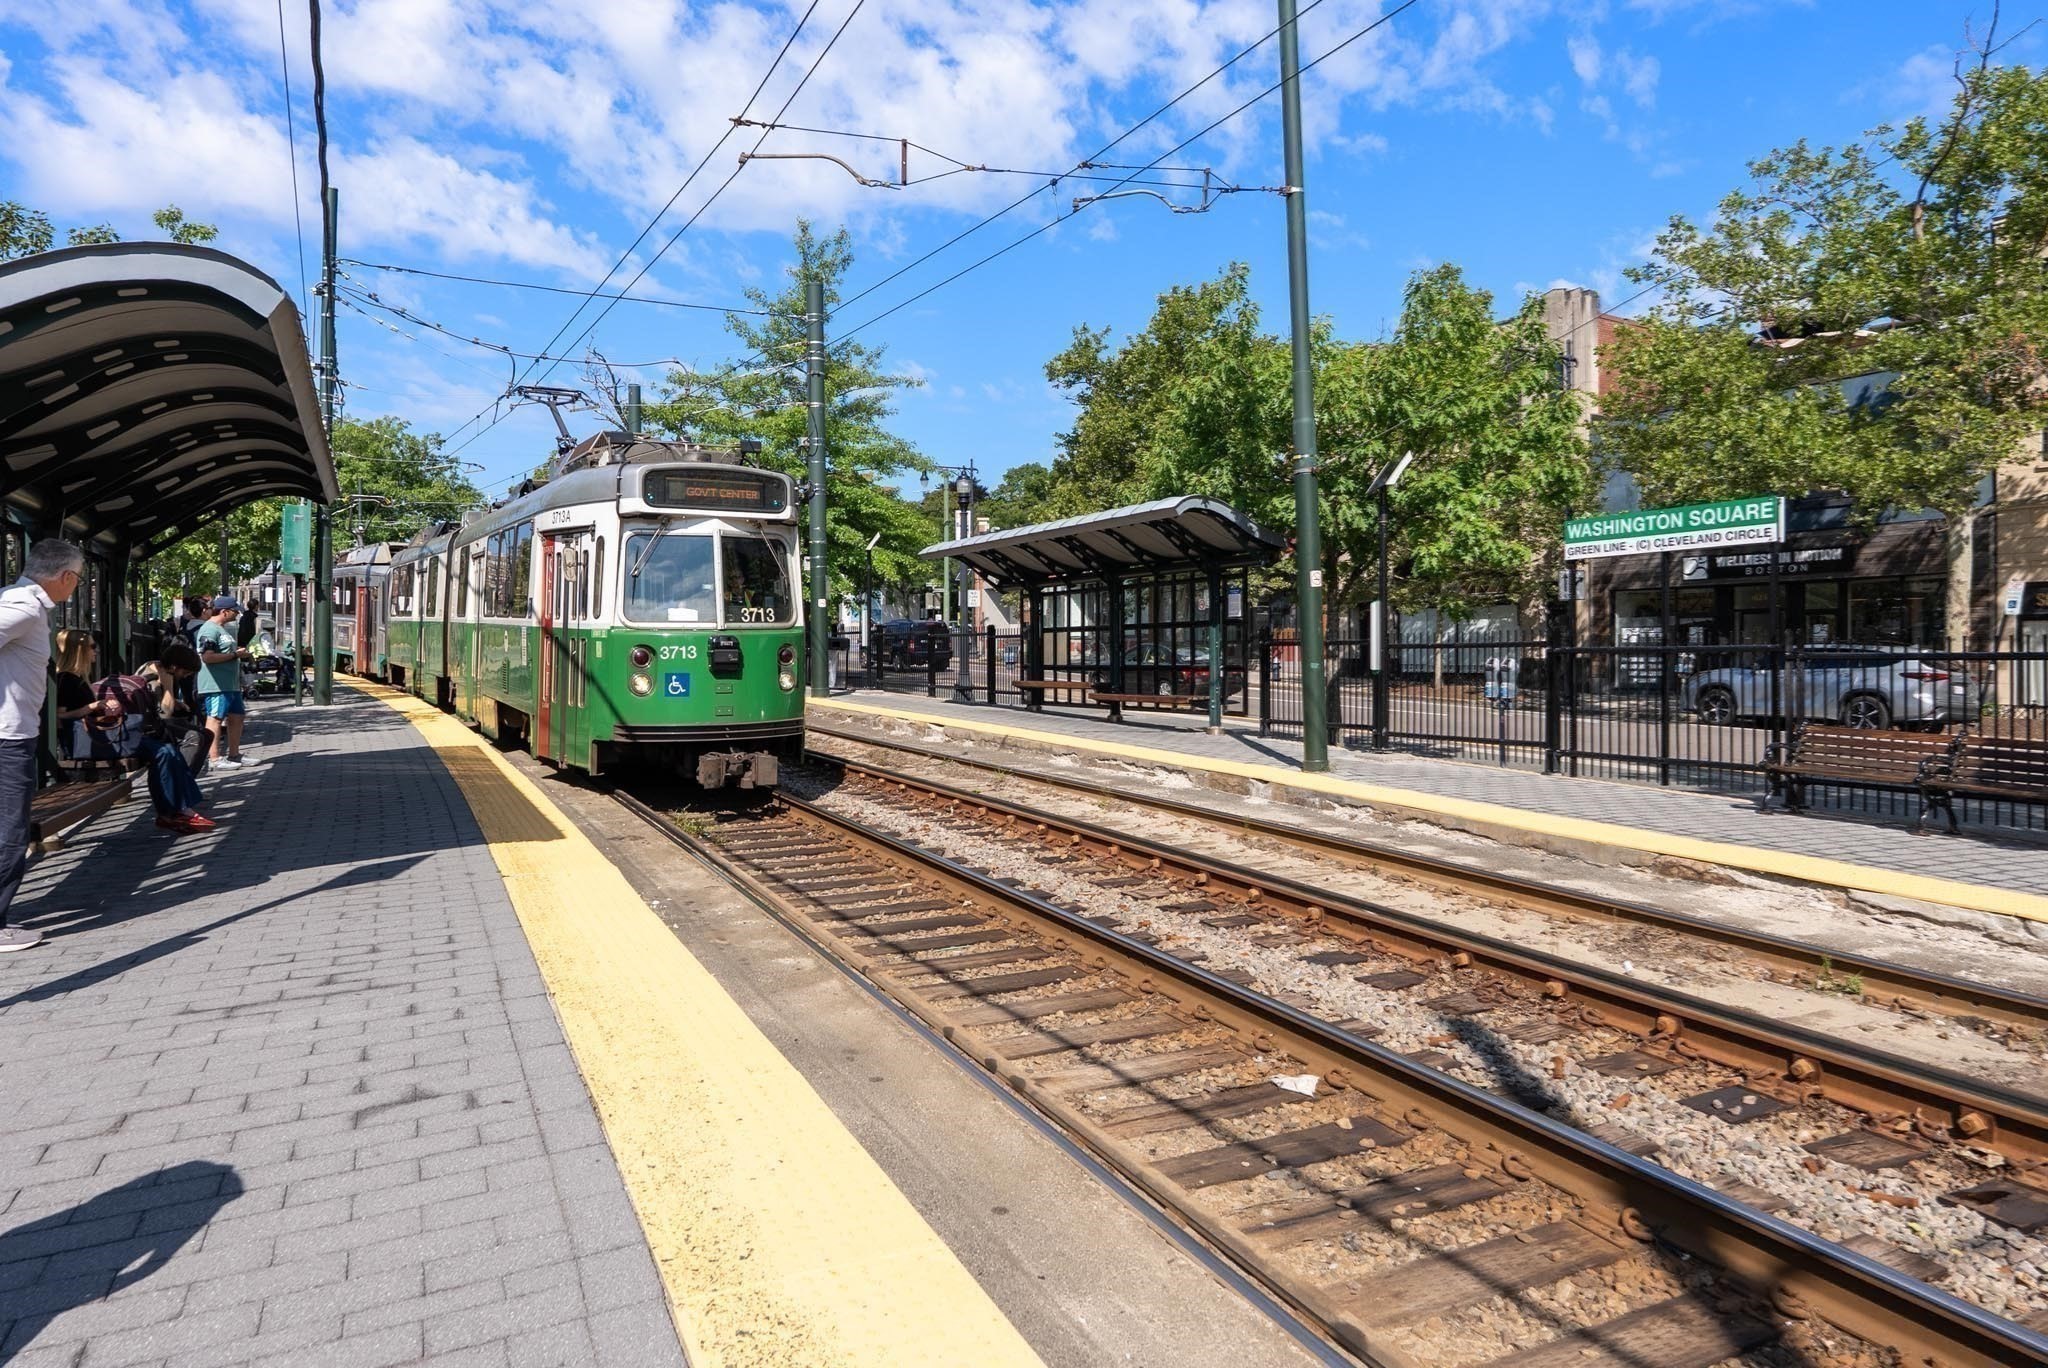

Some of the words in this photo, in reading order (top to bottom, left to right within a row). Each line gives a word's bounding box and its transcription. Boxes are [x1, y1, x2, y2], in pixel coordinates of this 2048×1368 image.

[719, 489, 759, 500] CENTER
[551, 509, 572, 525] 3713A
[1567, 511, 1683, 539] WASHINGTON
[1688, 501, 1774, 527] SQUARE
[1567, 544, 1600, 556] GREEN
[1603, 541, 1626, 553] LINE
[1636, 538, 1651, 551] (C)
[1653, 532, 1722, 548] CLEVELAND
[1725, 527, 1773, 541] CIRCLE
[1745, 563, 1809, 576] BOSTON
[741, 607, 775, 623] 3713
[660, 645, 697, 660] 3713
